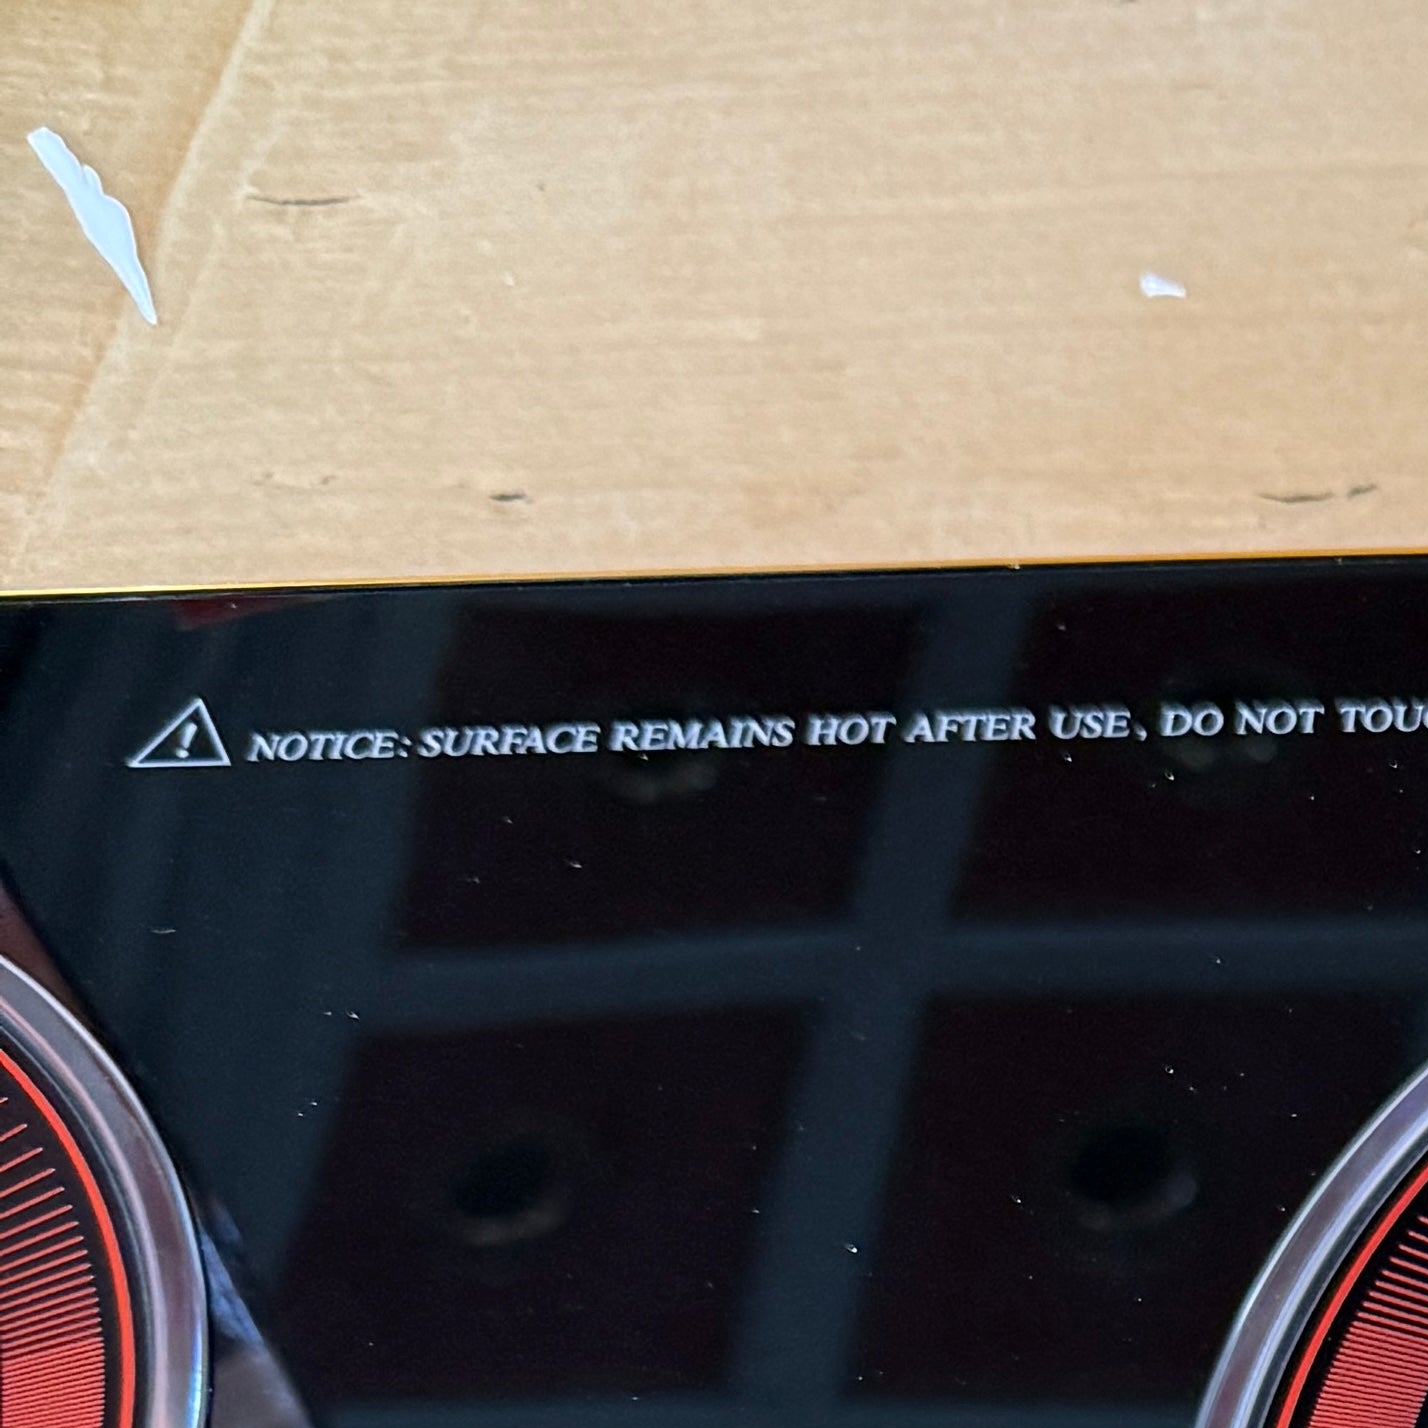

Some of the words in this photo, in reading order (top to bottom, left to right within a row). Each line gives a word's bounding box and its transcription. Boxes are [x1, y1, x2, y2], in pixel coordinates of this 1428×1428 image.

[247, 729, 411, 763] NOTICE:
[417, 723, 601, 758] SURFACE
[609, 716, 796, 752] REMAINS
[806, 713, 898, 746] HOT
[904, 710, 1037, 743] AFTER
[1049, 707, 1148, 742] USE,
[1160, 704, 1225, 737] DO
[1236, 702, 1325, 735] NOT
